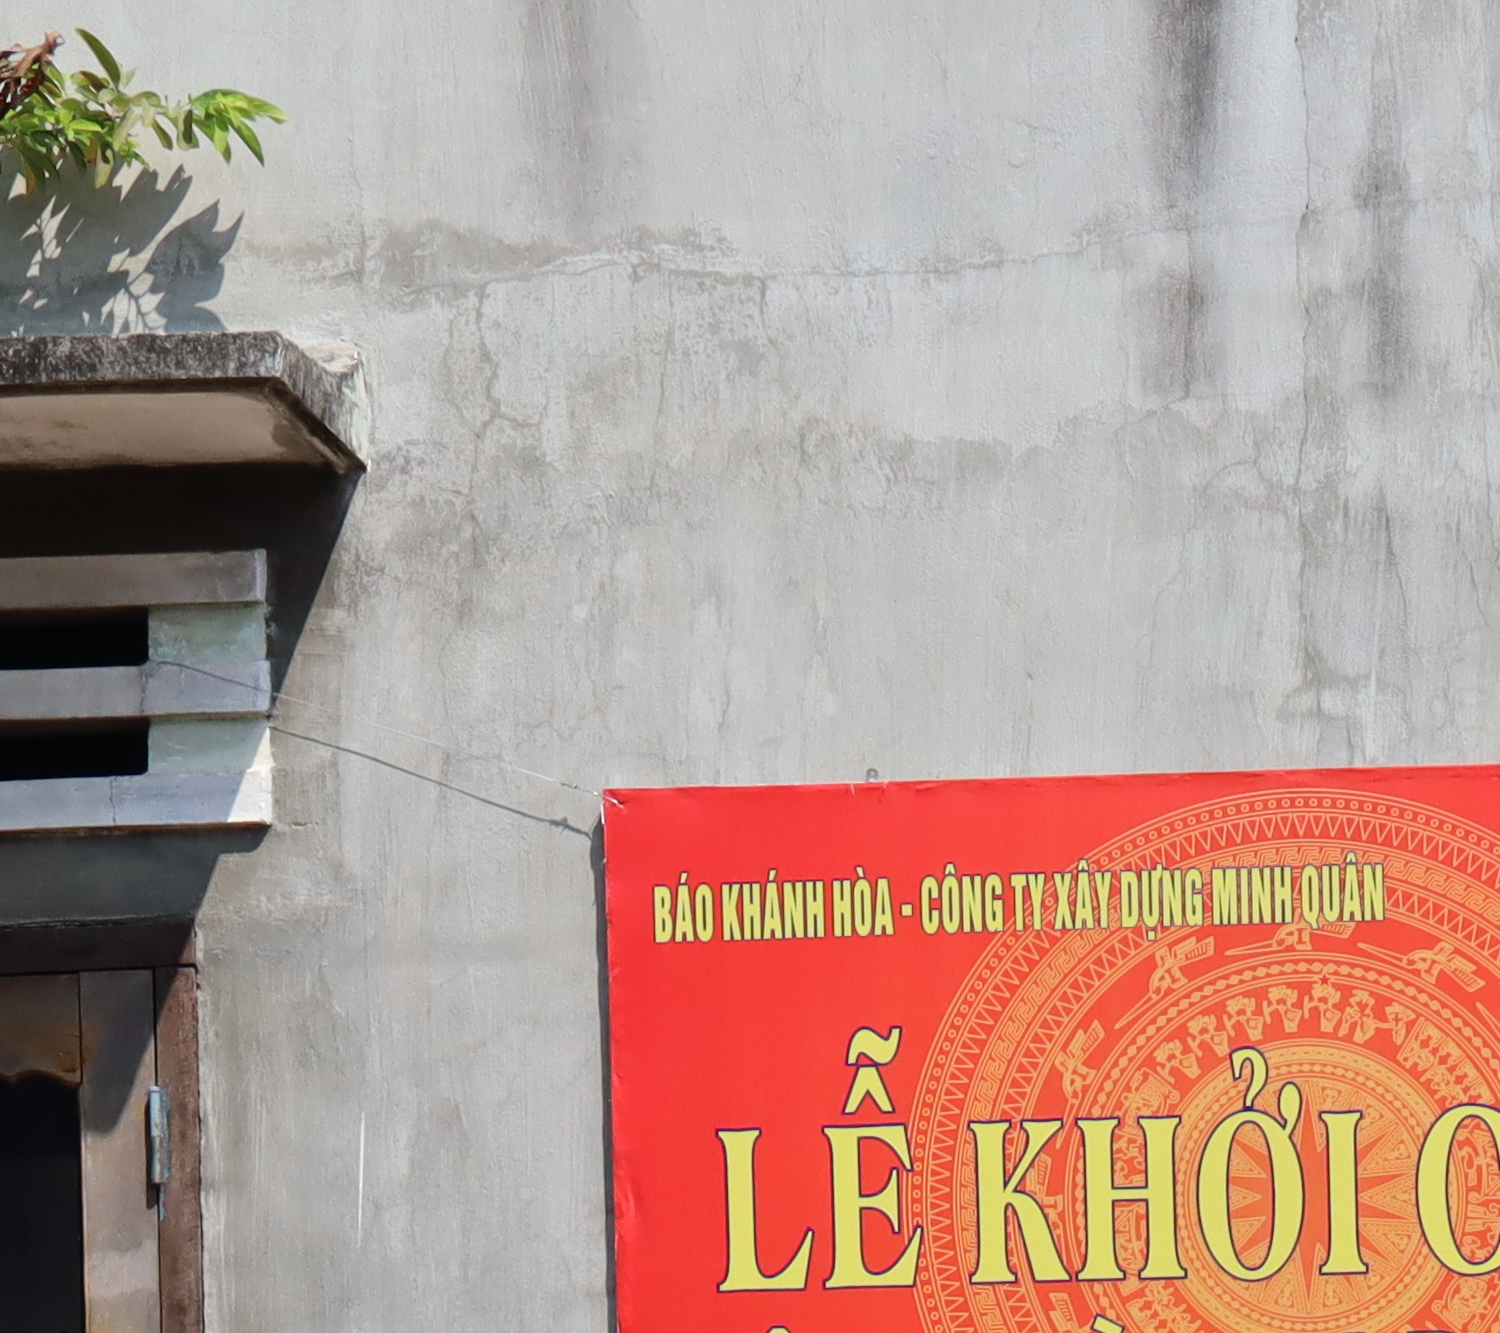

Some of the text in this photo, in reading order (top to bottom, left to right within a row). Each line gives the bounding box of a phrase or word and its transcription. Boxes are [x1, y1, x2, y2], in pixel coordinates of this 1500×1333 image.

[654, 873, 712, 941] BÁO
[723, 870, 823, 940] KHÁNH
[833, 867, 893, 936] HÒA
[921, 863, 1002, 934] CÔNG
[1012, 873, 1044, 931] TY
[1054, 859, 1110, 929] XÂY
[1122, 864, 1202, 940] DỰNG
[1213, 867, 1292, 925] MINH
[1302, 852, 1384, 928] QUÂN
[716, 1026, 921, 1292] LỄ
[969, 1047, 1367, 1285] KHỞI
